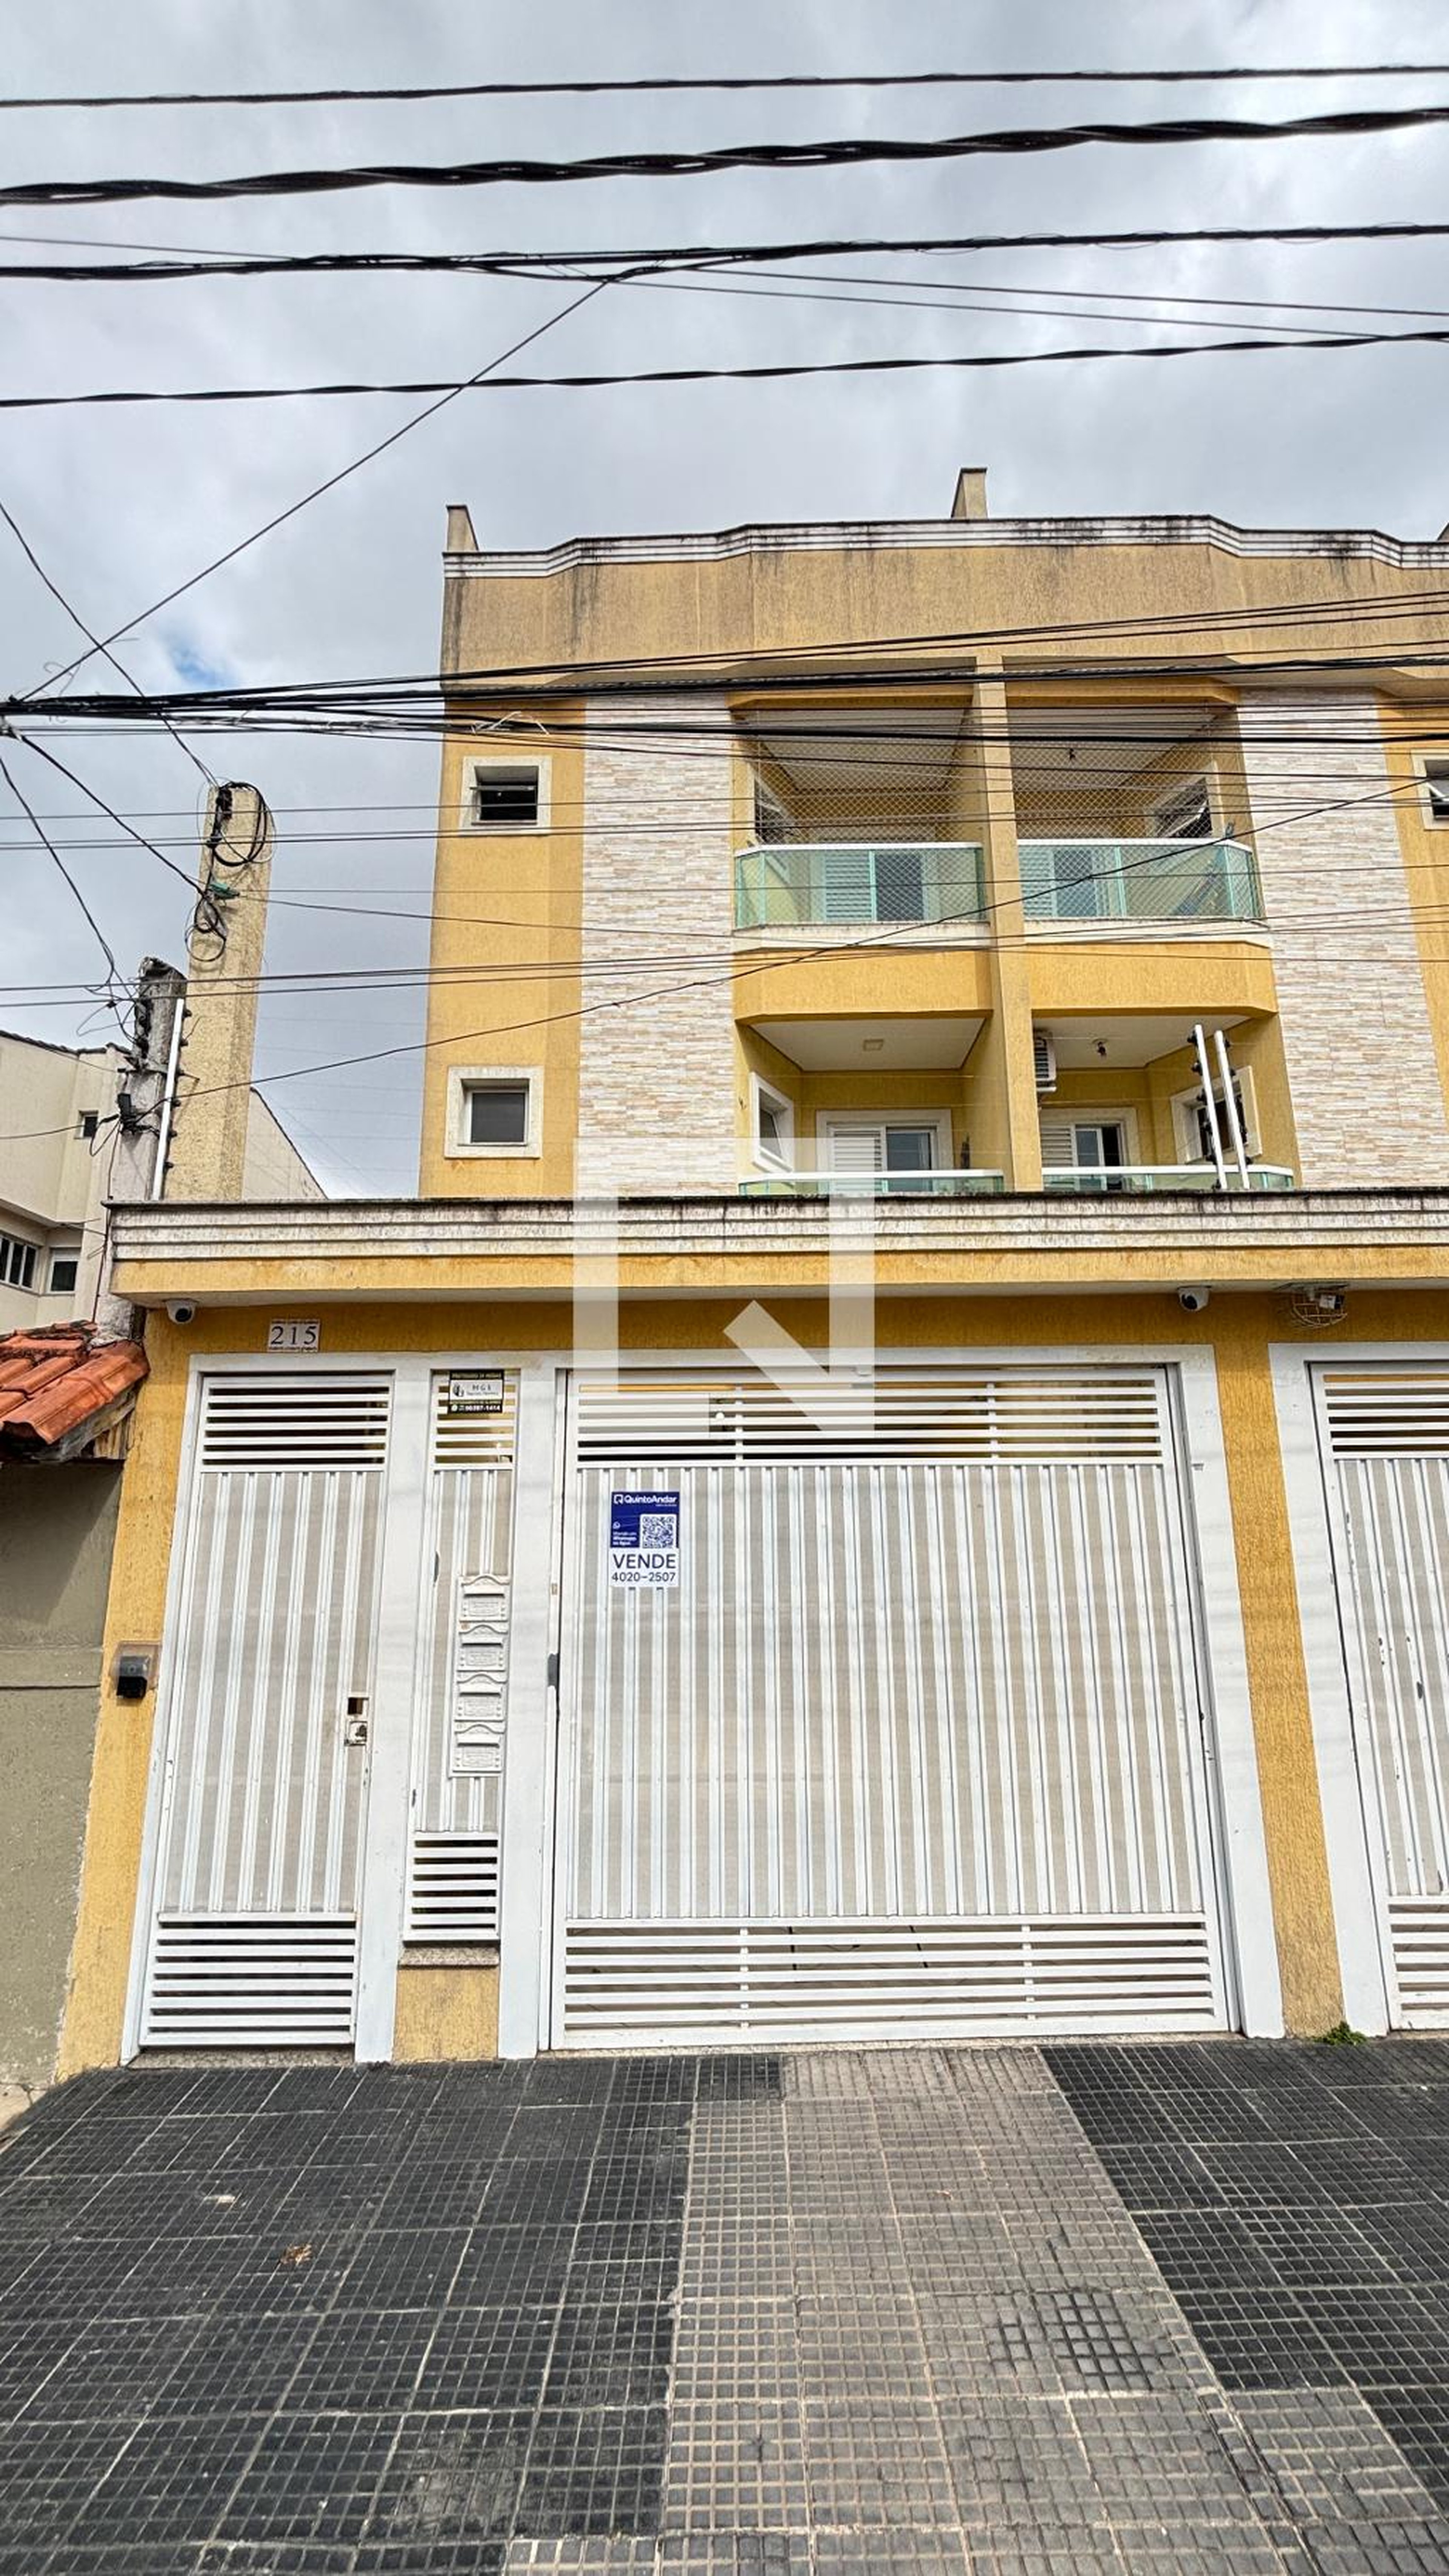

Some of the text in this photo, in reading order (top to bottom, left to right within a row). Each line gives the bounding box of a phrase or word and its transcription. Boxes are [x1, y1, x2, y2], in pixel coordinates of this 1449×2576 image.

[271, 1326, 317, 1345] 215
[624, 1495, 677, 1503] QuintoAndar
[613, 1554, 676, 1569] VENDE
[612, 1572, 675, 1582] 4020-2507
